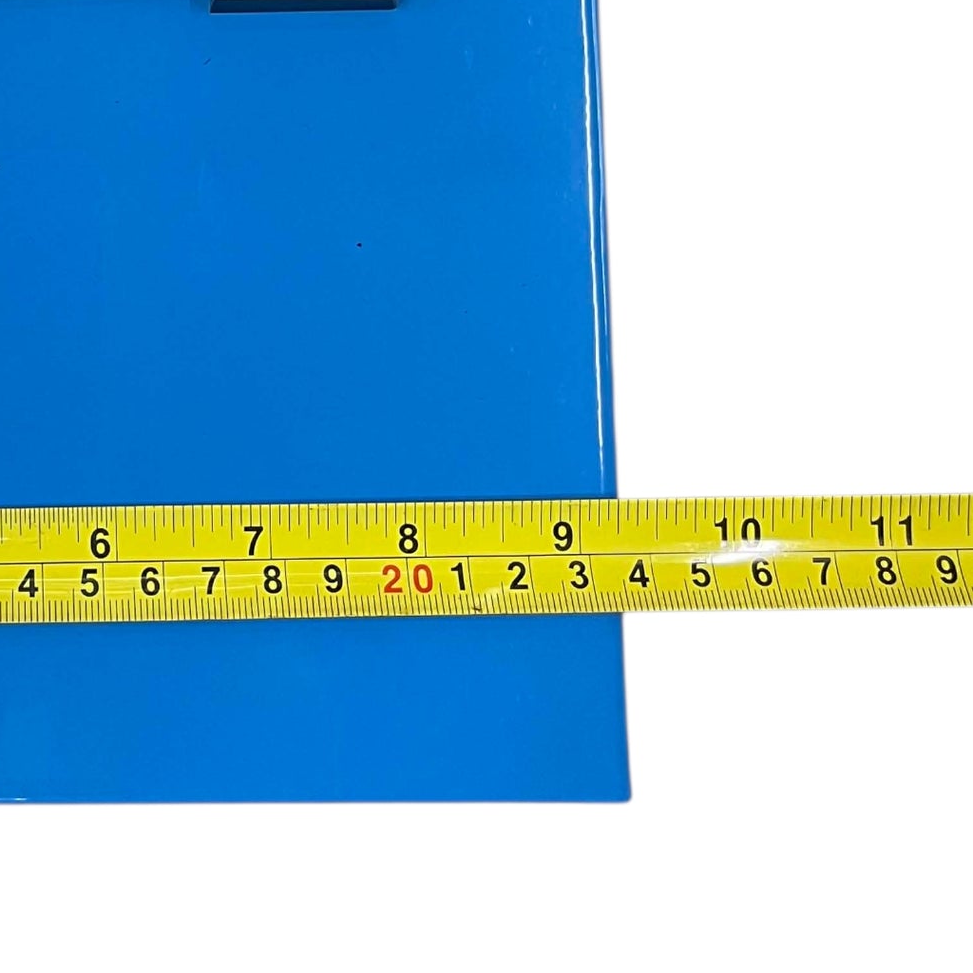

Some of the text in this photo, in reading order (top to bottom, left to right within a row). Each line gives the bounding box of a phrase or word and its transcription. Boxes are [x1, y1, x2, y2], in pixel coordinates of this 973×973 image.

[90, 529, 110, 559] 6
[244, 526, 263, 556] 7
[398, 524, 418, 554] 8
[553, 521, 573, 551] 9
[714, 517, 760, 547] 10
[871, 515, 913, 546] 11
[18, 569, 38, 598] 4
[80, 569, 99, 597] 5
[141, 567, 160, 596] 6
[201, 567, 220, 595] 7
[263, 566, 282, 594] 8
[323, 565, 343, 592] 9
[382, 565, 433, 594] 20
[451, 562, 465, 590] 1
[507, 562, 529, 590] 2
[568, 561, 589, 589] 3
[629, 559, 650, 588] 4
[691, 562, 711, 587] 5
[752, 560, 772, 586] 6
[812, 557, 831, 585] 7
[876, 556, 897, 585] 8
[936, 555, 957, 584] 9
